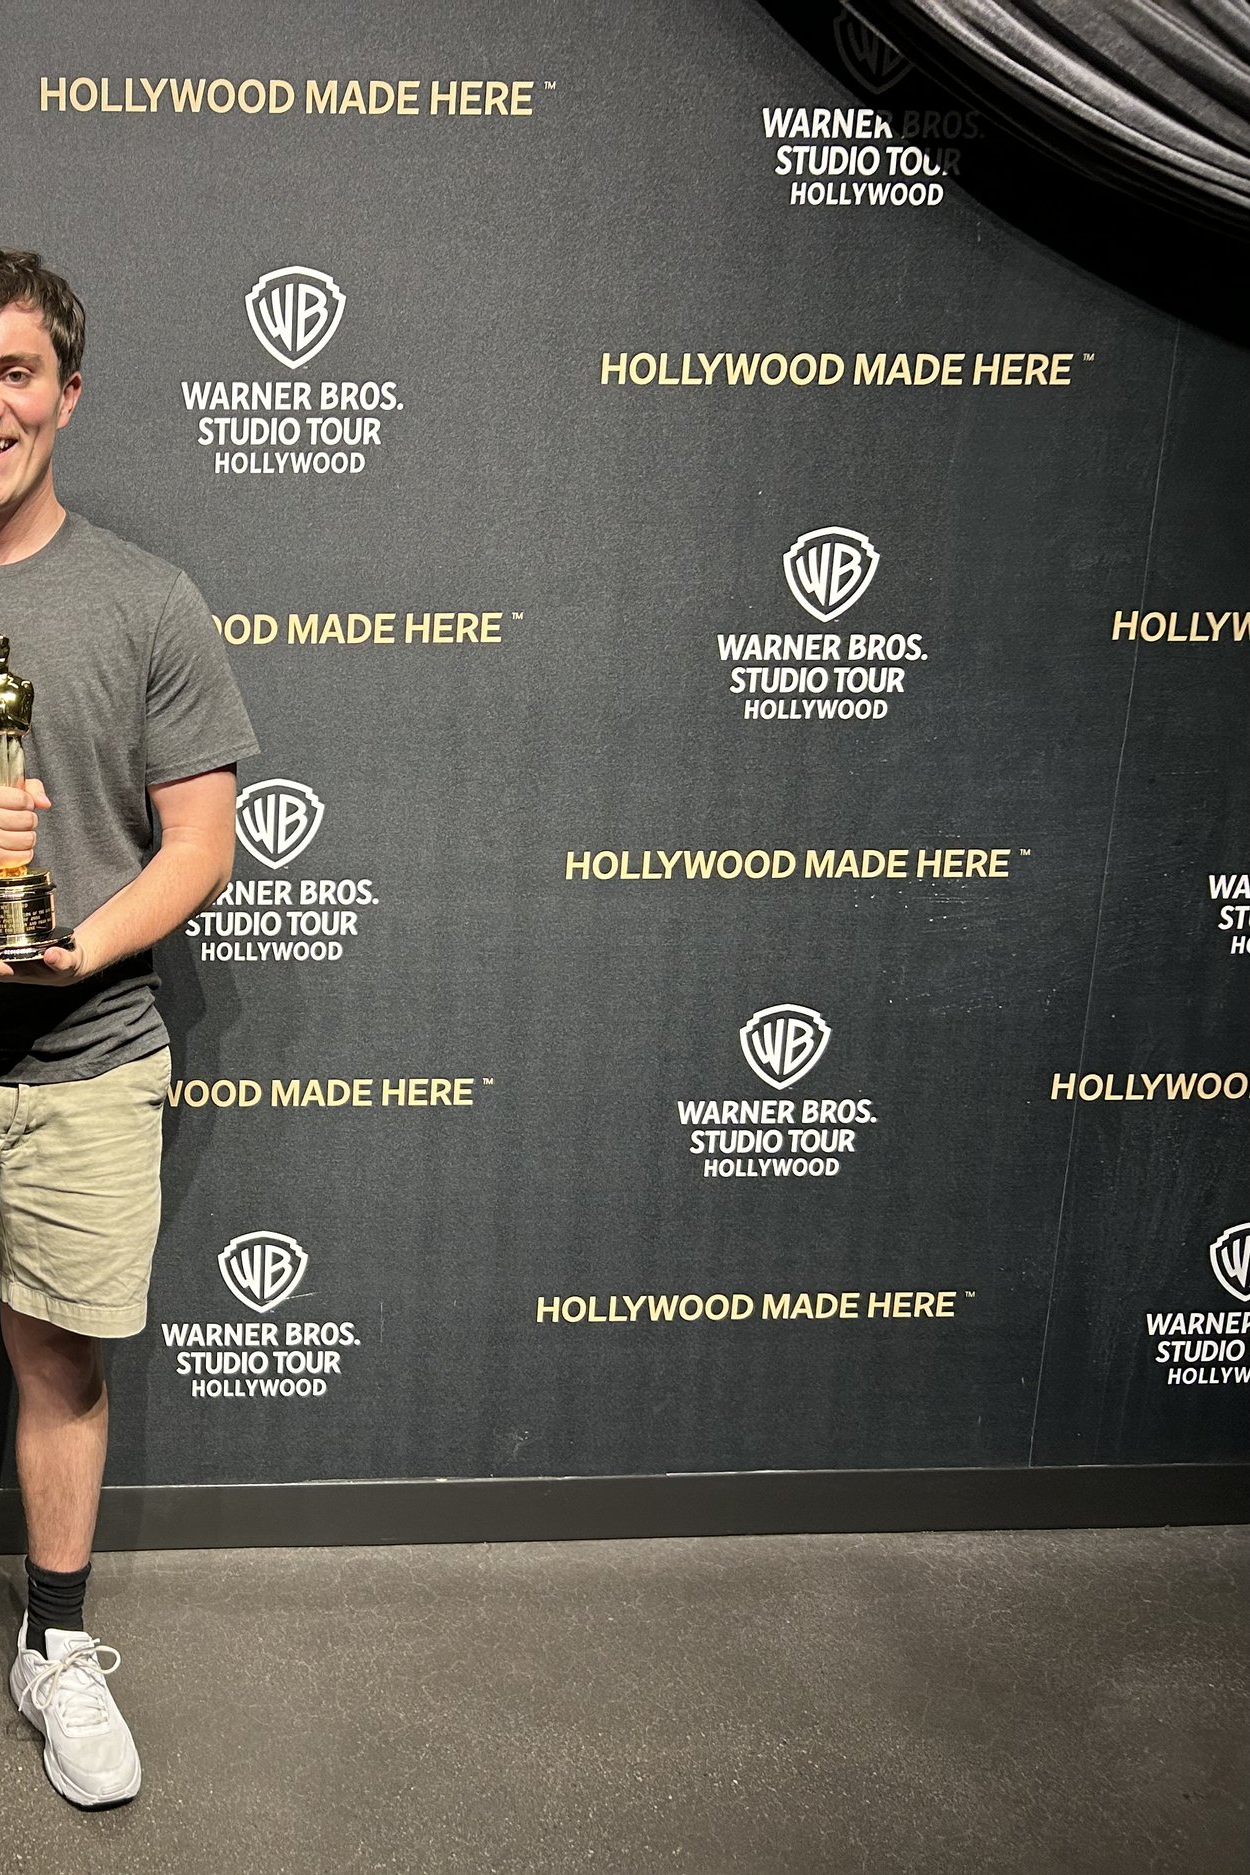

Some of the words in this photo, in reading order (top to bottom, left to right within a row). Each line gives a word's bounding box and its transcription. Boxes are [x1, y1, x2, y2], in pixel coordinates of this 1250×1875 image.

[40, 76, 295, 114] HOLLYWOOD
[305, 79, 421, 115] MADE
[430, 80, 535, 116] HERE
[774, 144, 881, 176] STUDIO
[790, 181, 944, 206] HOLLYWOOD
[600, 352, 845, 386] HOLLYWOOD
[853, 353, 966, 386] MADE
[972, 353, 1074, 386] HERE
[181, 381, 312, 411] WARNER
[320, 381, 404, 411] BROS.
[197, 416, 301, 446] STUDIO
[305, 416, 382, 446] TOUR
[214, 451, 366, 474] HOLLYWOOD
[287, 613, 397, 645] MADE
[405, 612, 504, 644] HERE
[717, 633, 841, 661] WARNER
[847, 633, 928, 661] BROS.
[729, 666, 829, 694] STUDIO
[833, 666, 906, 694] TOUR
[743, 698, 888, 720] HOLLYWOOD
[565, 849, 797, 880] HOLLYWOOD
[804, 849, 909, 879] MADE
[916, 848, 1011, 878] HERE
[211, 879, 293, 906] RNER
[299, 878, 380, 906] BROS.
[184, 910, 282, 937] STUDIO
[286, 910, 358, 936] TOUR
[201, 941, 343, 962] HOLLYWOOD
[271, 1078, 374, 1107] MADE
[381, 1078, 475, 1107] HERE
[1050, 1072, 1250, 1101] HOLLYWOO
[677, 1099, 795, 1125] WARNER
[801, 1098, 878, 1124] BROS.
[689, 1129, 784, 1154] STUDIO
[787, 1128, 856, 1153] TOUR
[703, 1157, 840, 1178] HOLLYWOOD
[536, 1294, 754, 1323] HOLLYWOOD
[762, 1292, 861, 1320] MADE
[867, 1291, 957, 1318] HERE
[161, 1322, 279, 1347] WARNER
[285, 1321, 361, 1346] BROS.
[176, 1350, 269, 1375] STUDIO
[272, 1350, 342, 1375] TOUR
[1155, 1339, 1246, 1363] STUDIO
[191, 1378, 327, 1398] HOLLYWOOD
